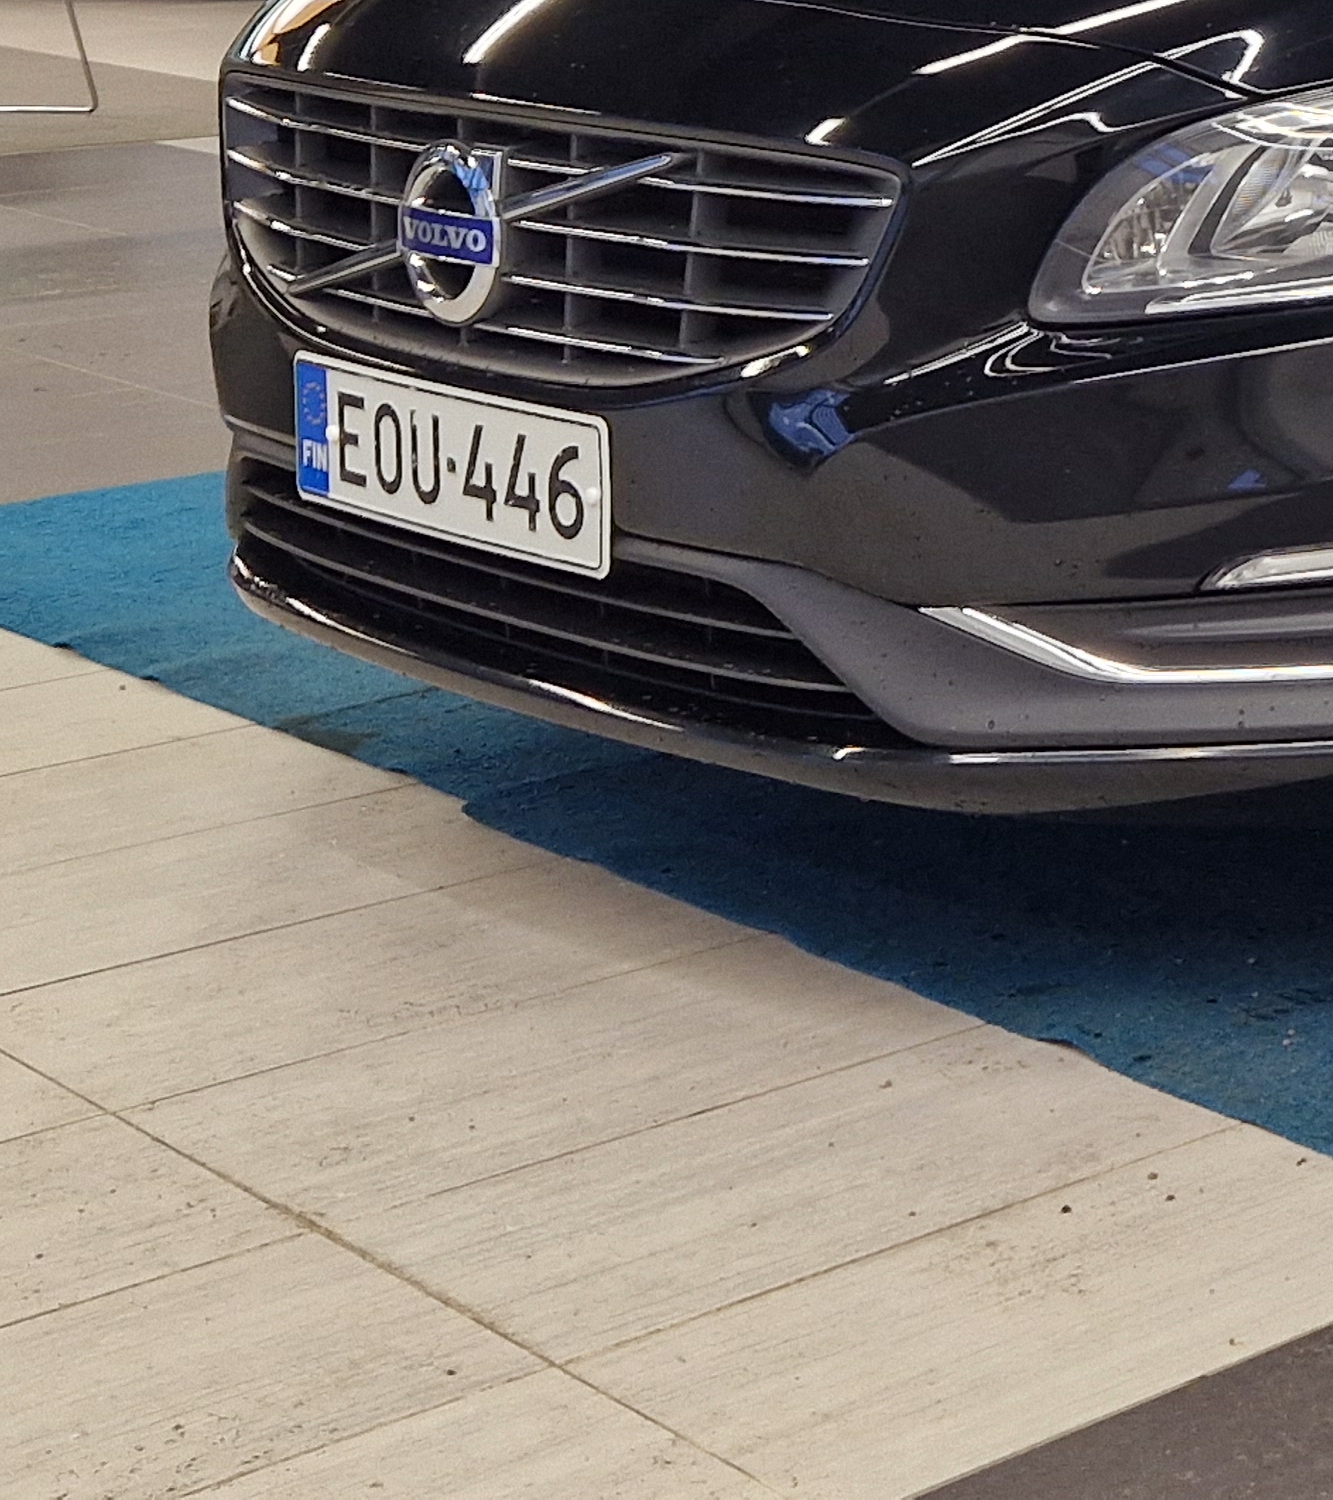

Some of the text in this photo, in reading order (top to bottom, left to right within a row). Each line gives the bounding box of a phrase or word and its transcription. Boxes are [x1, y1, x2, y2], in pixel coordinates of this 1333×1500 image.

[402, 218, 487, 253] VOLVO
[302, 438, 328, 473] FIN
[337, 393, 584, 540] EOU-446
